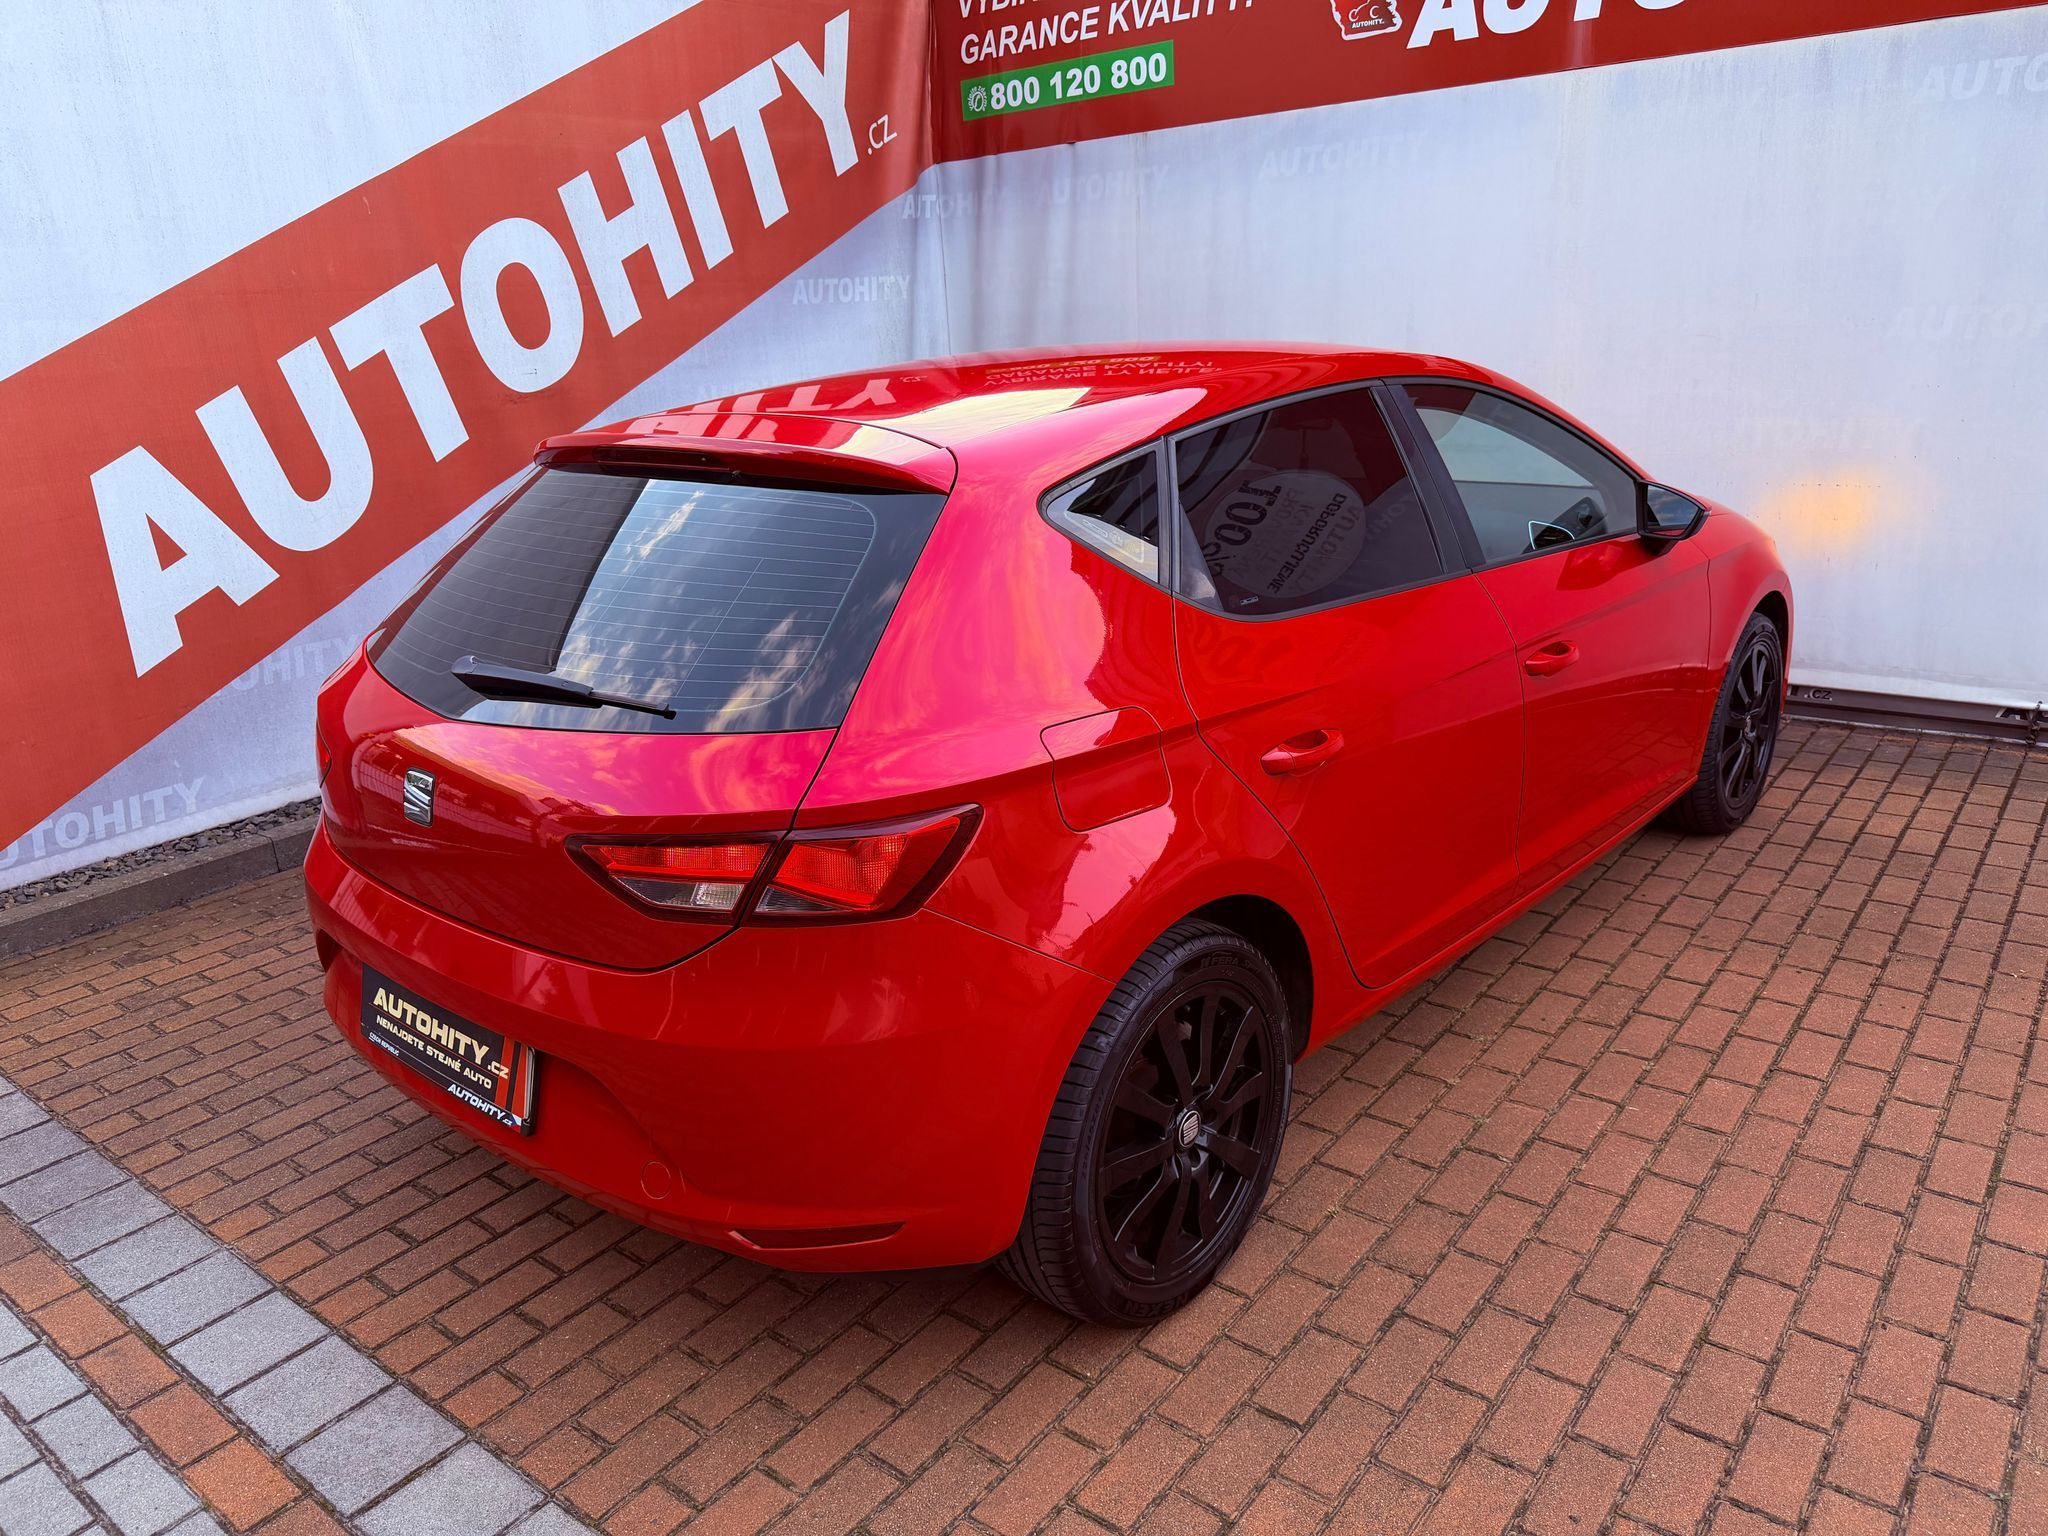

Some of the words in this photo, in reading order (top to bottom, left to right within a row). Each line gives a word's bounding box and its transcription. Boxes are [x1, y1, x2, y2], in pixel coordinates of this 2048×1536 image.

[961, 6, 1100, 65] GARANCE
[990, 76, 1040, 111] 800
[1049, 65, 1101, 100] 120
[1110, 52, 1167, 89] 800
[792, 274, 911, 305] AUTOHITY
[376, 1014, 424, 1052] NENAJDETE
[426, 1044, 462, 1072] STEJNÉ
[463, 1069, 492, 1090] AUTO
